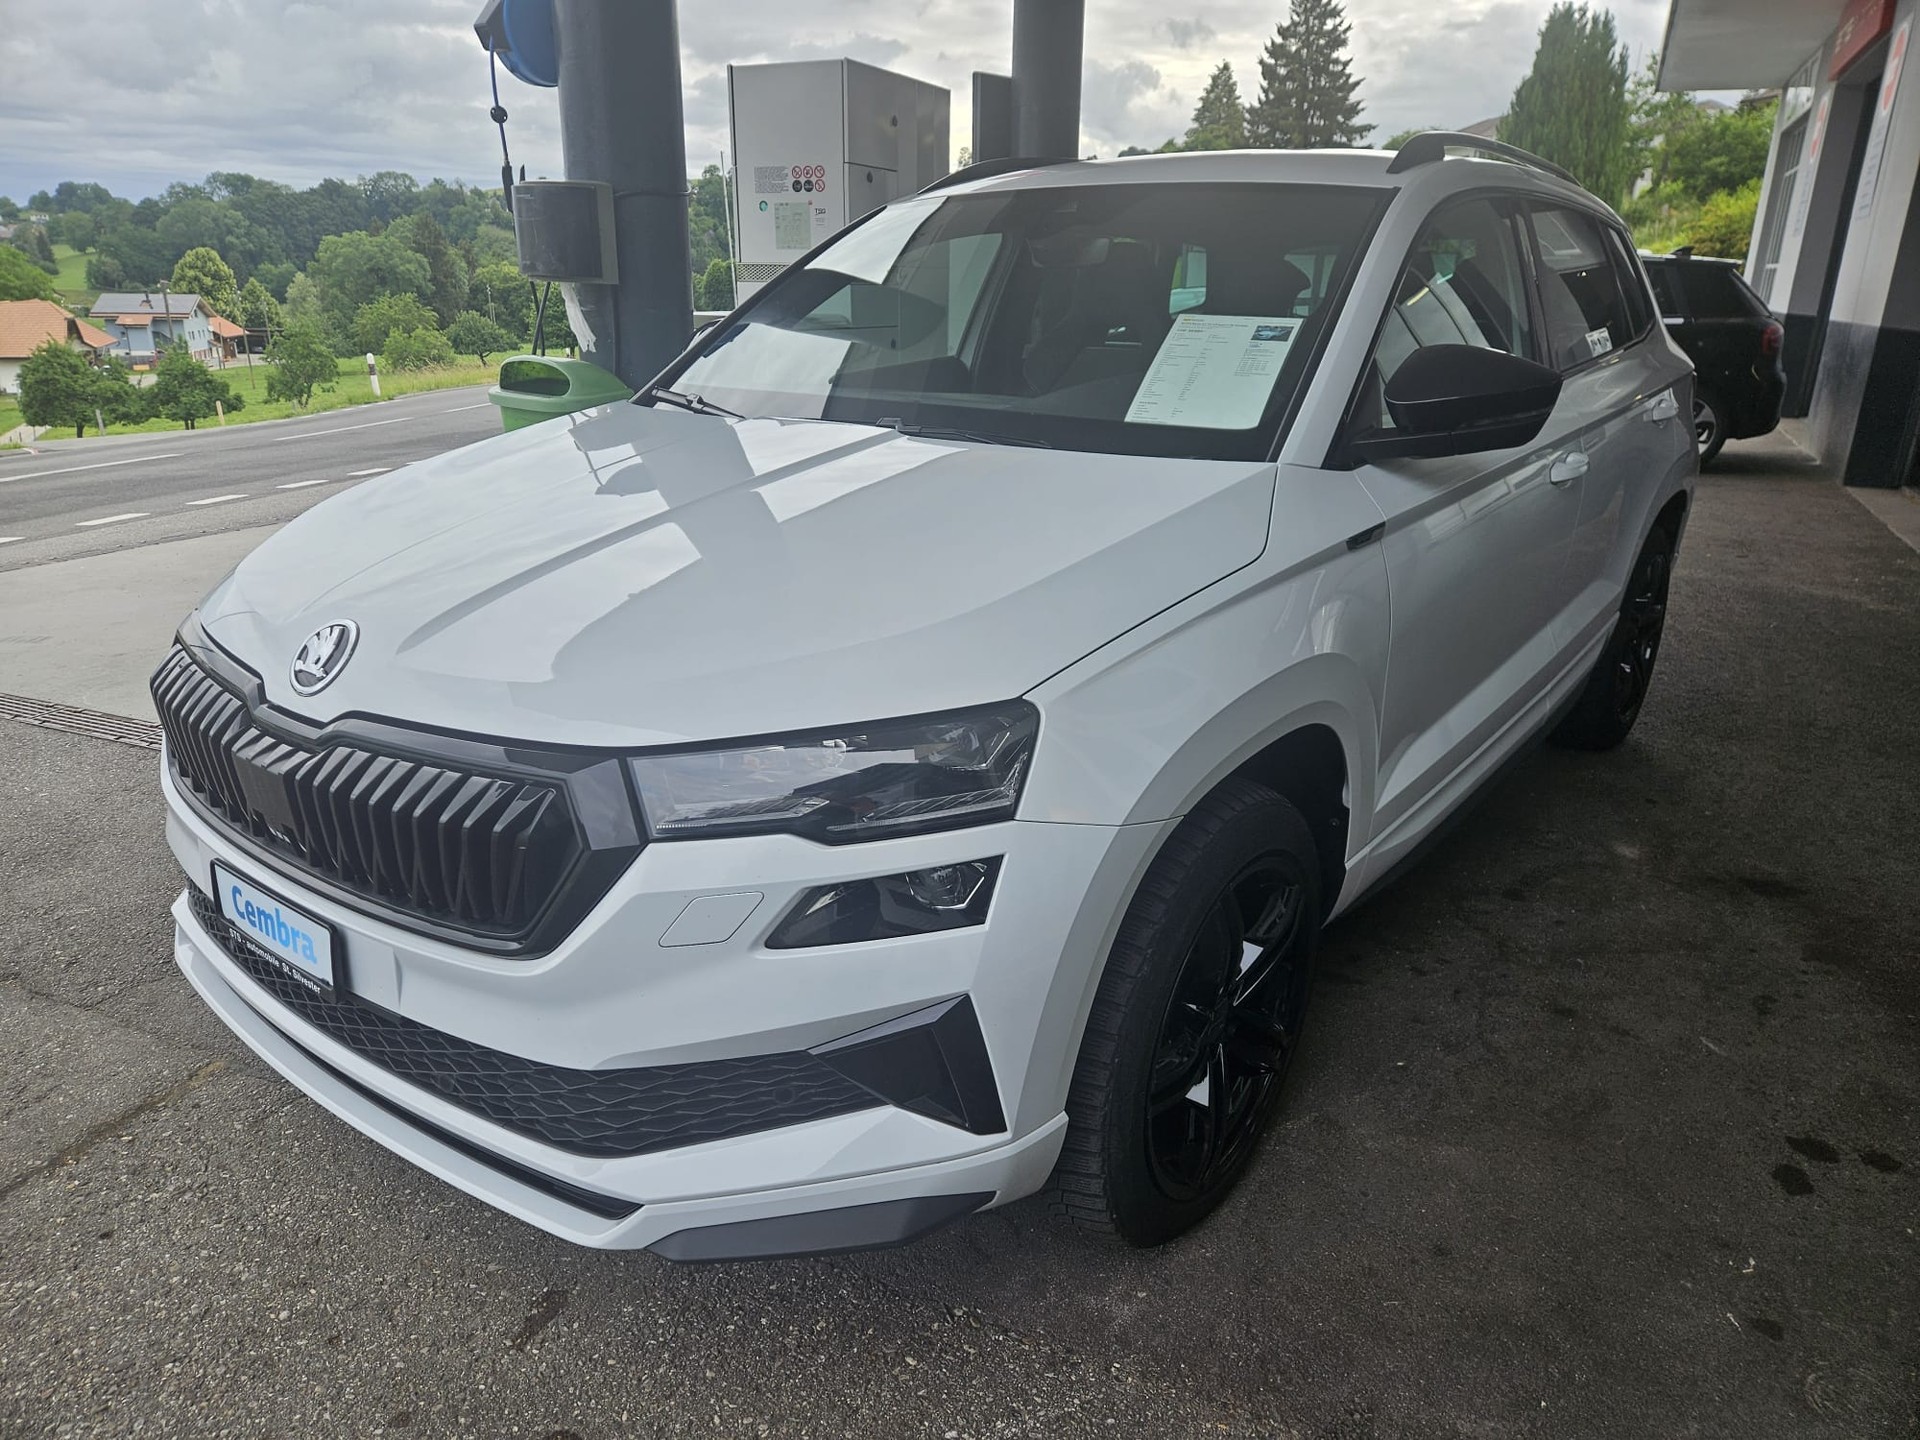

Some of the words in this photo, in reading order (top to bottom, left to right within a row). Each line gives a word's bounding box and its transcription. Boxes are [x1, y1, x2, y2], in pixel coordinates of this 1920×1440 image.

[232, 885, 317, 964] Cembra
[229, 928, 241, 943] STS
[246, 943, 280, 967] automobile
[282, 962, 292, 975] St.
[292, 969, 321, 994] Silvester
